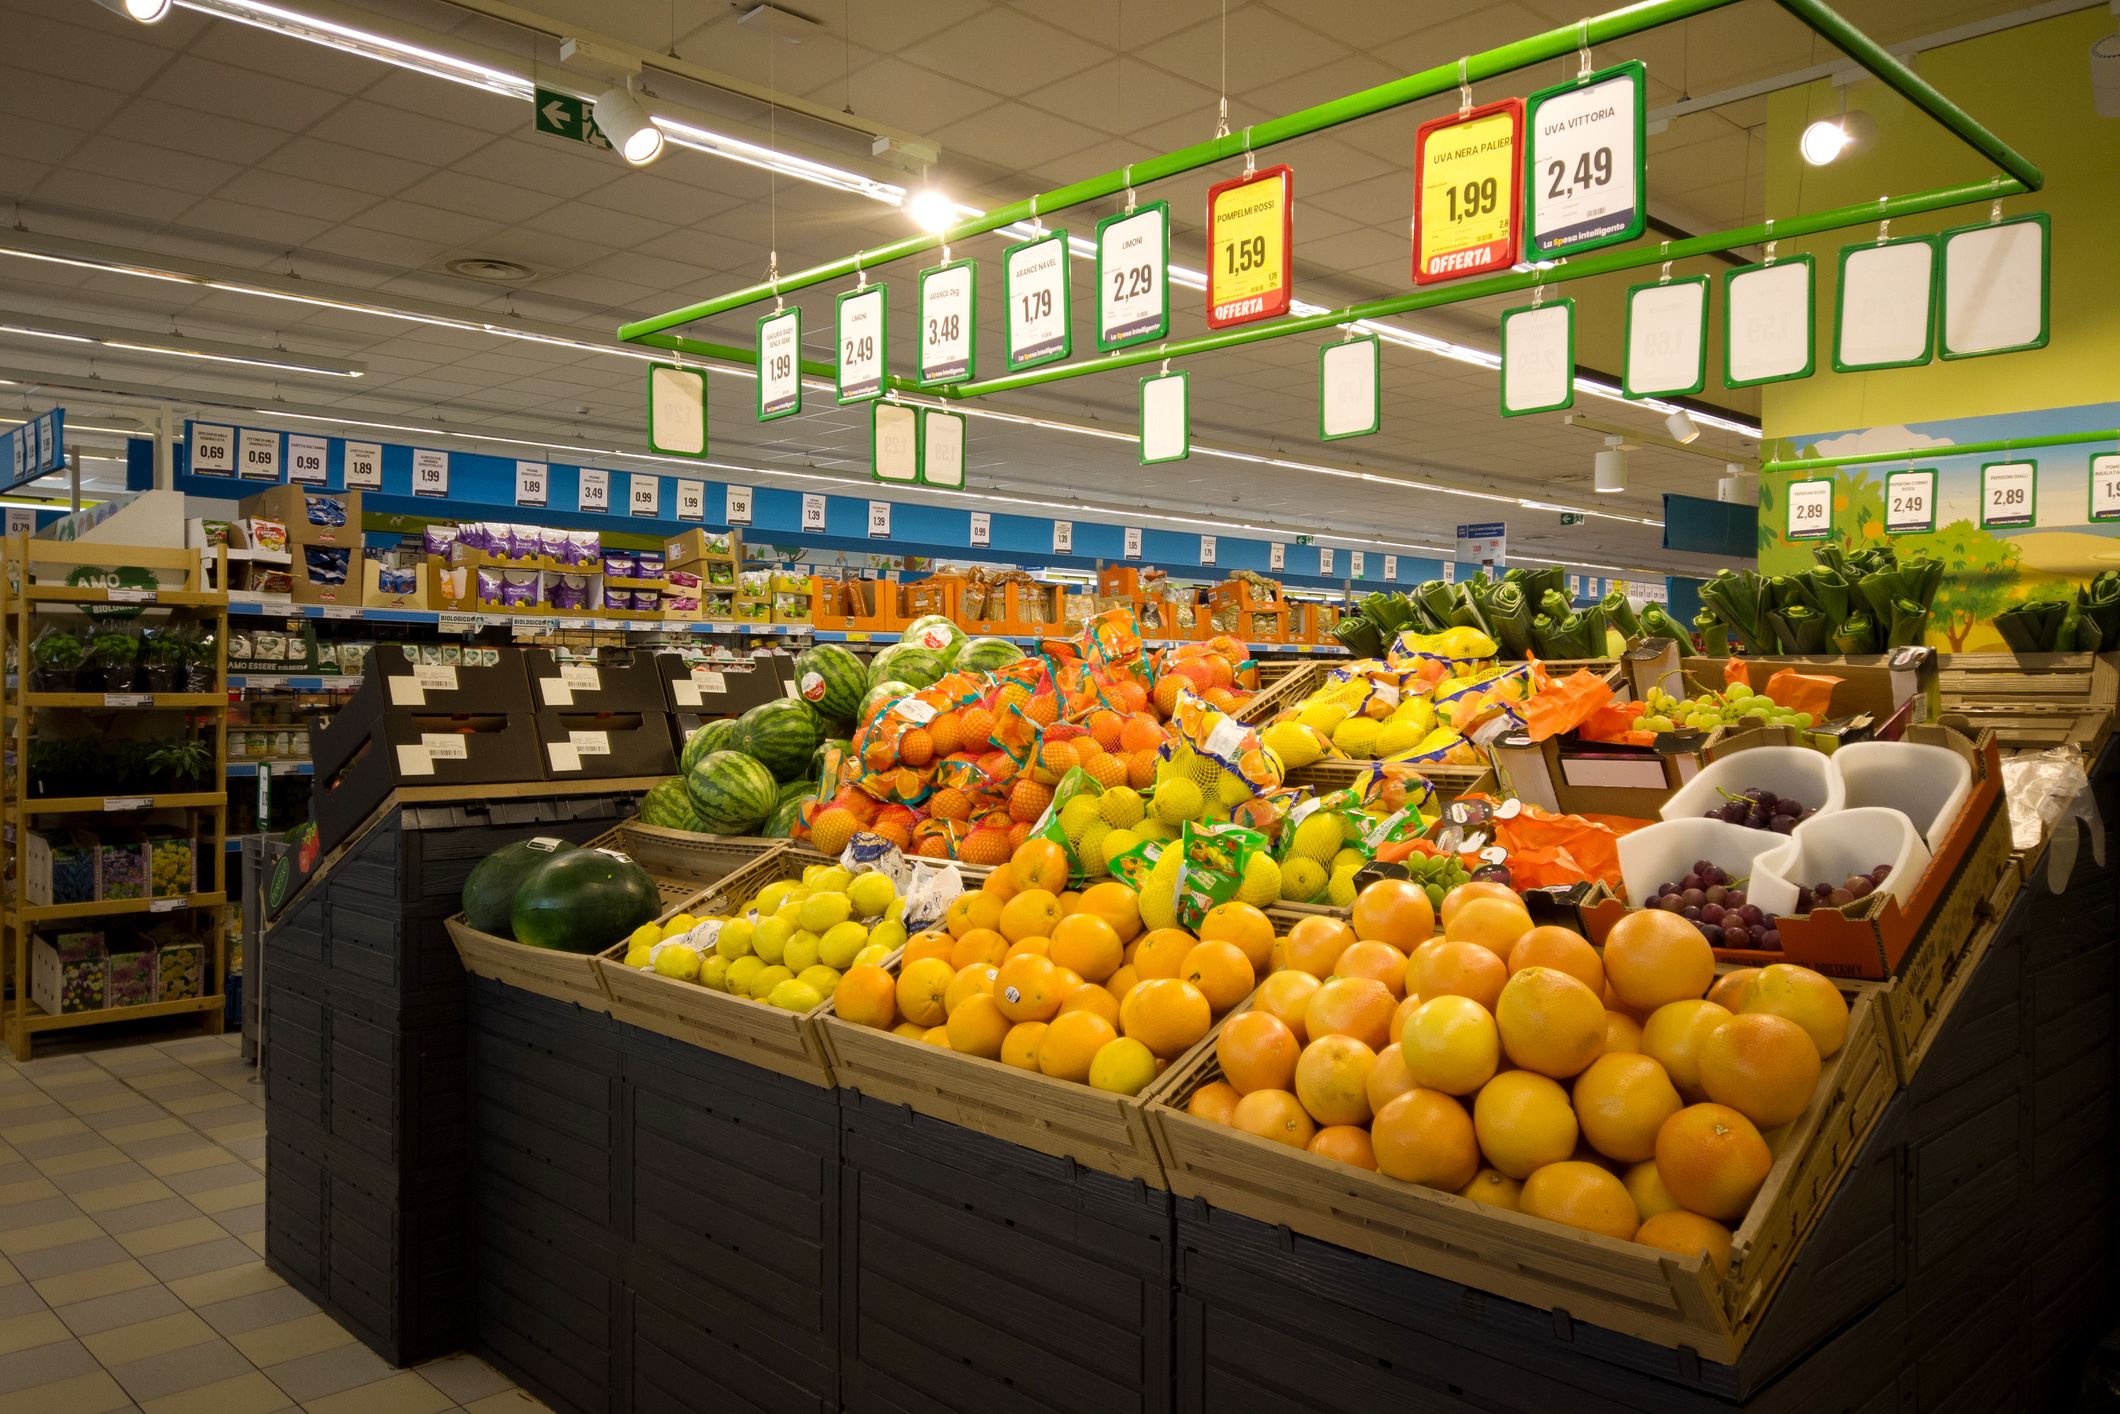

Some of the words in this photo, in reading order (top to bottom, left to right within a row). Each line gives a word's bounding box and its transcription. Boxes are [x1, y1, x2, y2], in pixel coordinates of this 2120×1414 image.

[1544, 121, 1566, 136] UVA
[1568, 106, 1615, 129] VITTORIA
[1433, 152, 1453, 165] UVA
[1455, 144, 1478, 160] NERA
[1548, 146, 1613, 199] 2,49
[1446, 177, 1497, 225] 1,99
[1217, 208, 1253, 224] POMPELMI
[1254, 200, 1275, 215] ROSSI
[1543, 239, 1553, 249] La
[1553, 234, 1578, 248] Spesa
[1578, 222, 1625, 241] intelligente
[1122, 237, 1143, 250] LIMONI
[1225, 235, 1266, 277] 1,59
[1430, 247, 1491, 275] OFFERTA
[1016, 265, 1038, 278] ARANCE
[1038, 258, 1057, 271] NAVEL
[1113, 264, 1153, 303] 2,29
[929, 290, 949, 301] ARANCE
[949, 288, 960, 297] 2kg
[1022, 288, 1052, 324] 1,79
[1215, 297, 1263, 321] OFFERTA
[851, 312, 868, 323] LIMONI
[929, 314, 960, 346] 3,48
[1110, 333, 1117, 341] La
[1132, 322, 1161, 336] intelligente
[845, 335, 873, 367] 2,49
[1037, 344, 1063, 357] intelligente
[769, 353, 791, 382] 1,99
[200, 445, 224, 460] 0,69
[249, 450, 272, 465] 0,69
[297, 456, 320, 470] 0,99
[353, 461, 372, 475] 1,89
[421, 469, 440, 482] 1,99
[523, 480, 540, 493] 1,89
[585, 486, 603, 499] 3,49
[635, 491, 652, 503] 0,99
[683, 497, 698, 508] 1,99
[1893, 496, 1923, 513] 2,49
[1993, 488, 2025, 506] 2,89
[732, 501, 746, 513] 1,99
[1796, 503, 1823, 519] 2,89
[807, 509, 820, 521] 1,39
[873, 516, 885, 527] 1,39
[78, 574, 120, 589] AMO
[440, 615, 471, 623] BIOLOGICO
[228, 661, 247, 670] AMO
[248, 662, 278, 670] ESSERE
